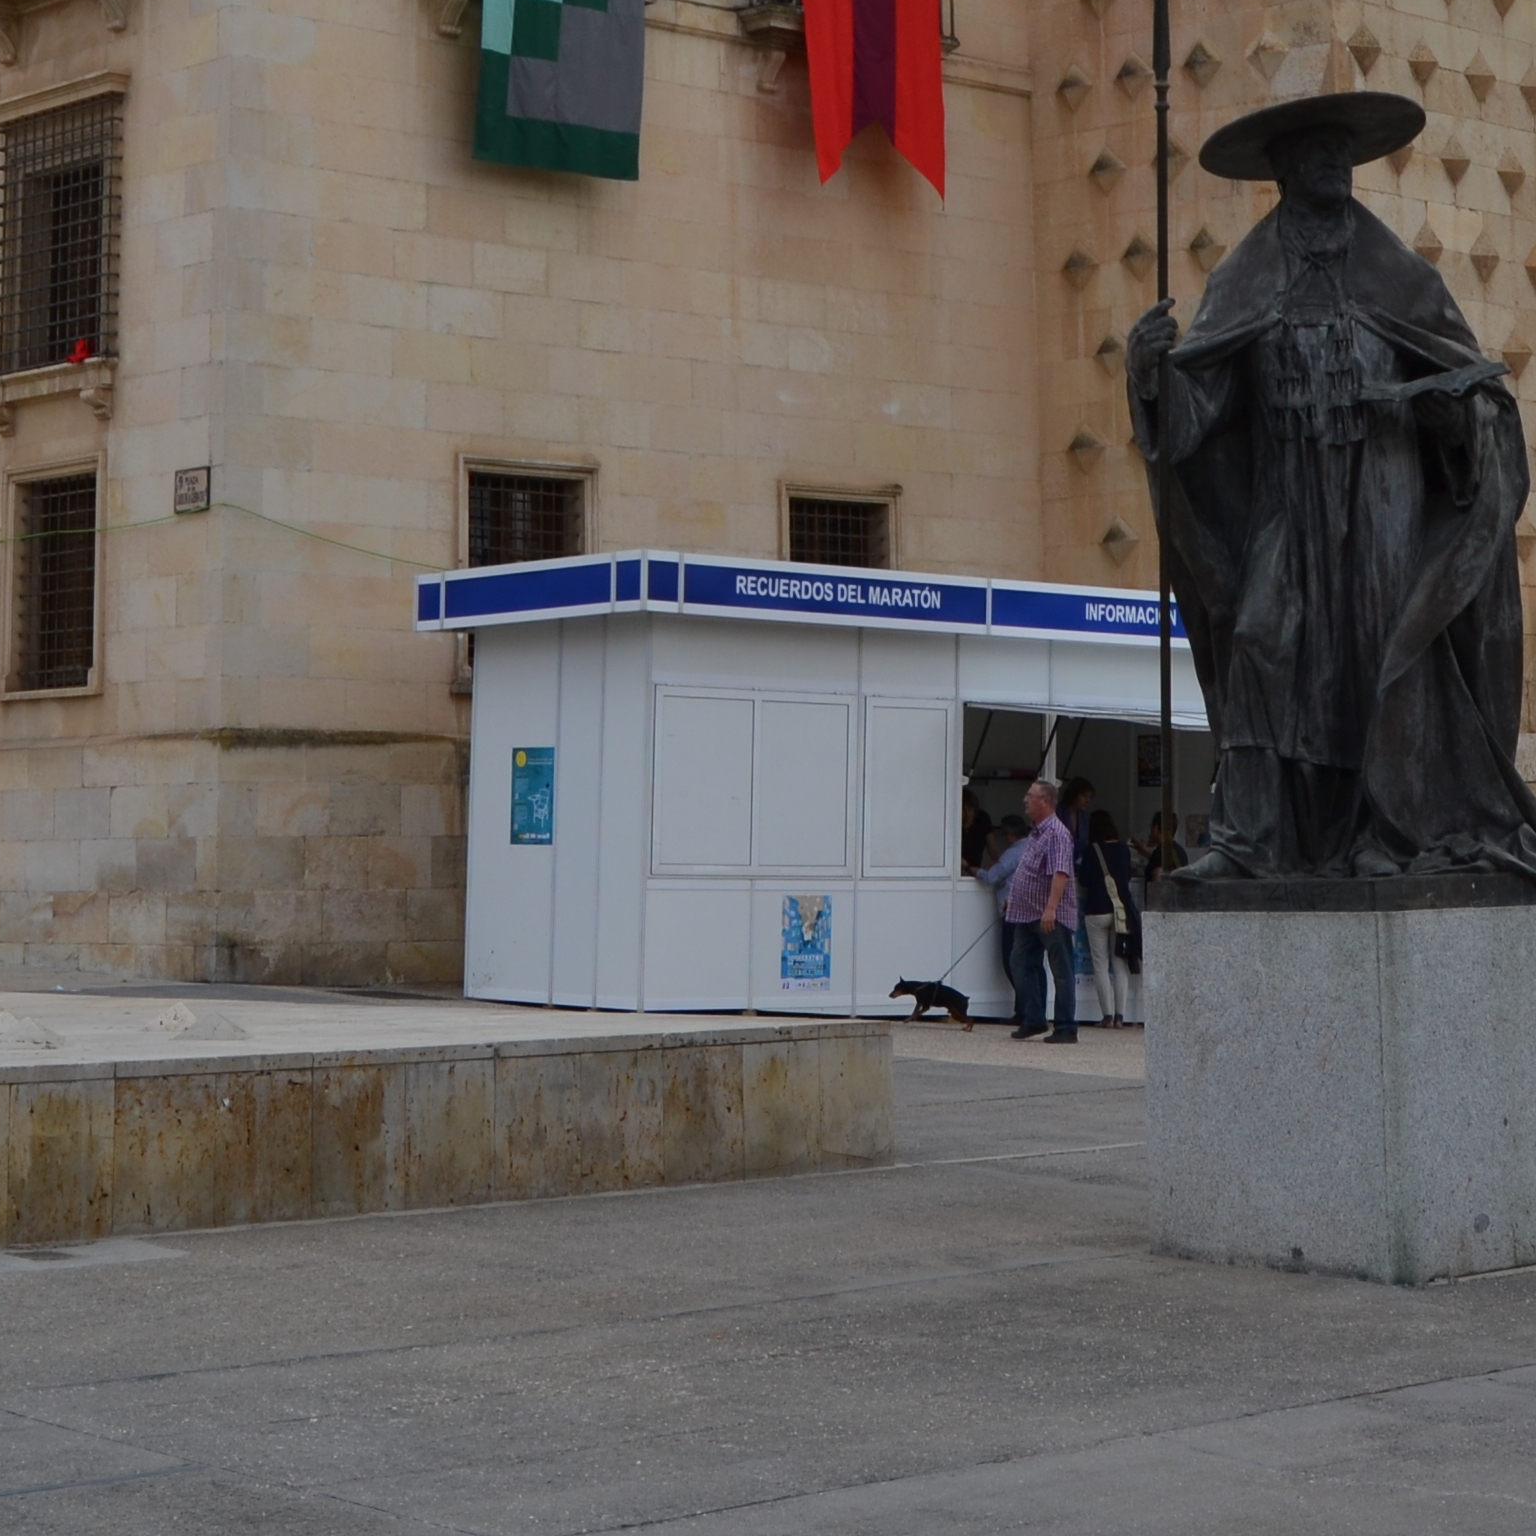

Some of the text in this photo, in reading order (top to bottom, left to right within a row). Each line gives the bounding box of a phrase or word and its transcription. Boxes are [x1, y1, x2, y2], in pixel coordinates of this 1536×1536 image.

[736, 575, 941, 609] RECUERDOS DEL MARATÓN
[1085, 602, 1177, 626] INFORMACIN
